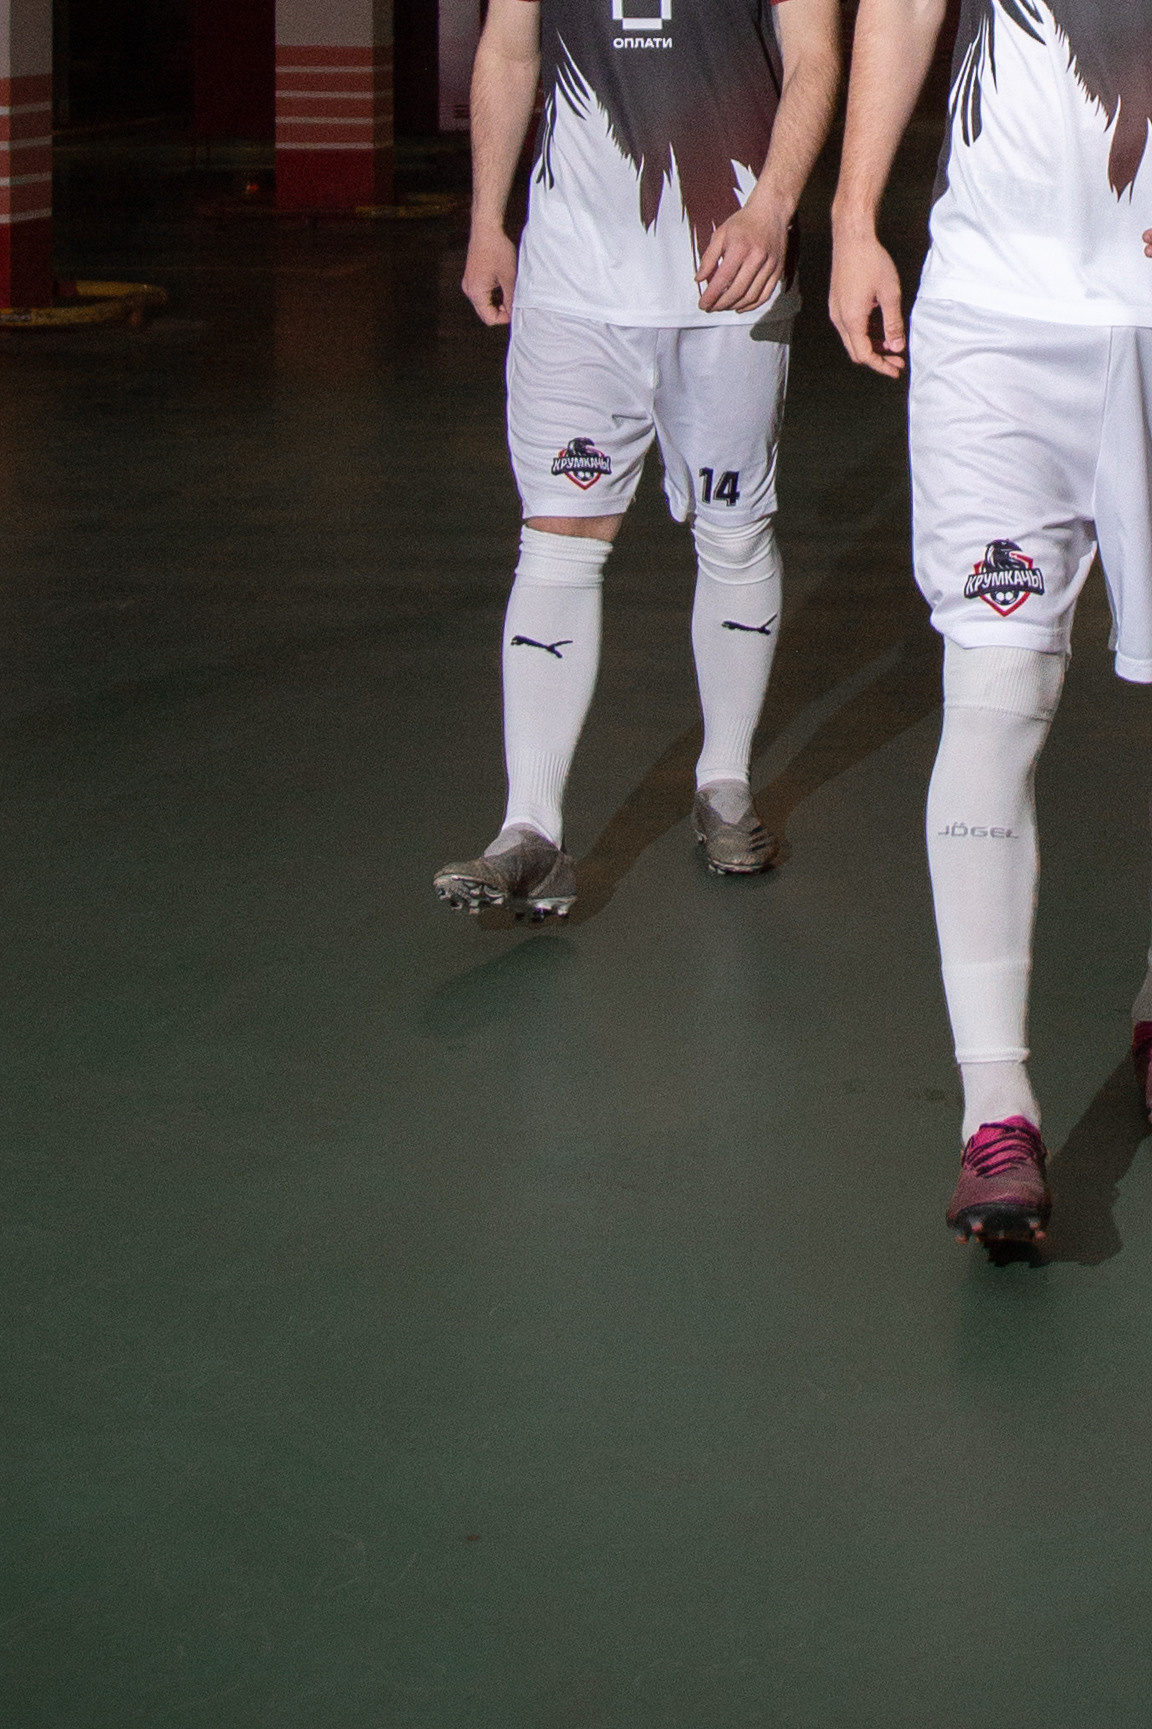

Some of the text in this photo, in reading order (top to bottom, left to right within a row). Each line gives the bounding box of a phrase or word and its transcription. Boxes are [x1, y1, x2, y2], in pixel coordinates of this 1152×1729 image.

[613, 37, 673, 49] ОПЛАТИ
[699, 466, 740, 507] 14
[965, 569, 1043, 596] КРУМКАЧЫ
